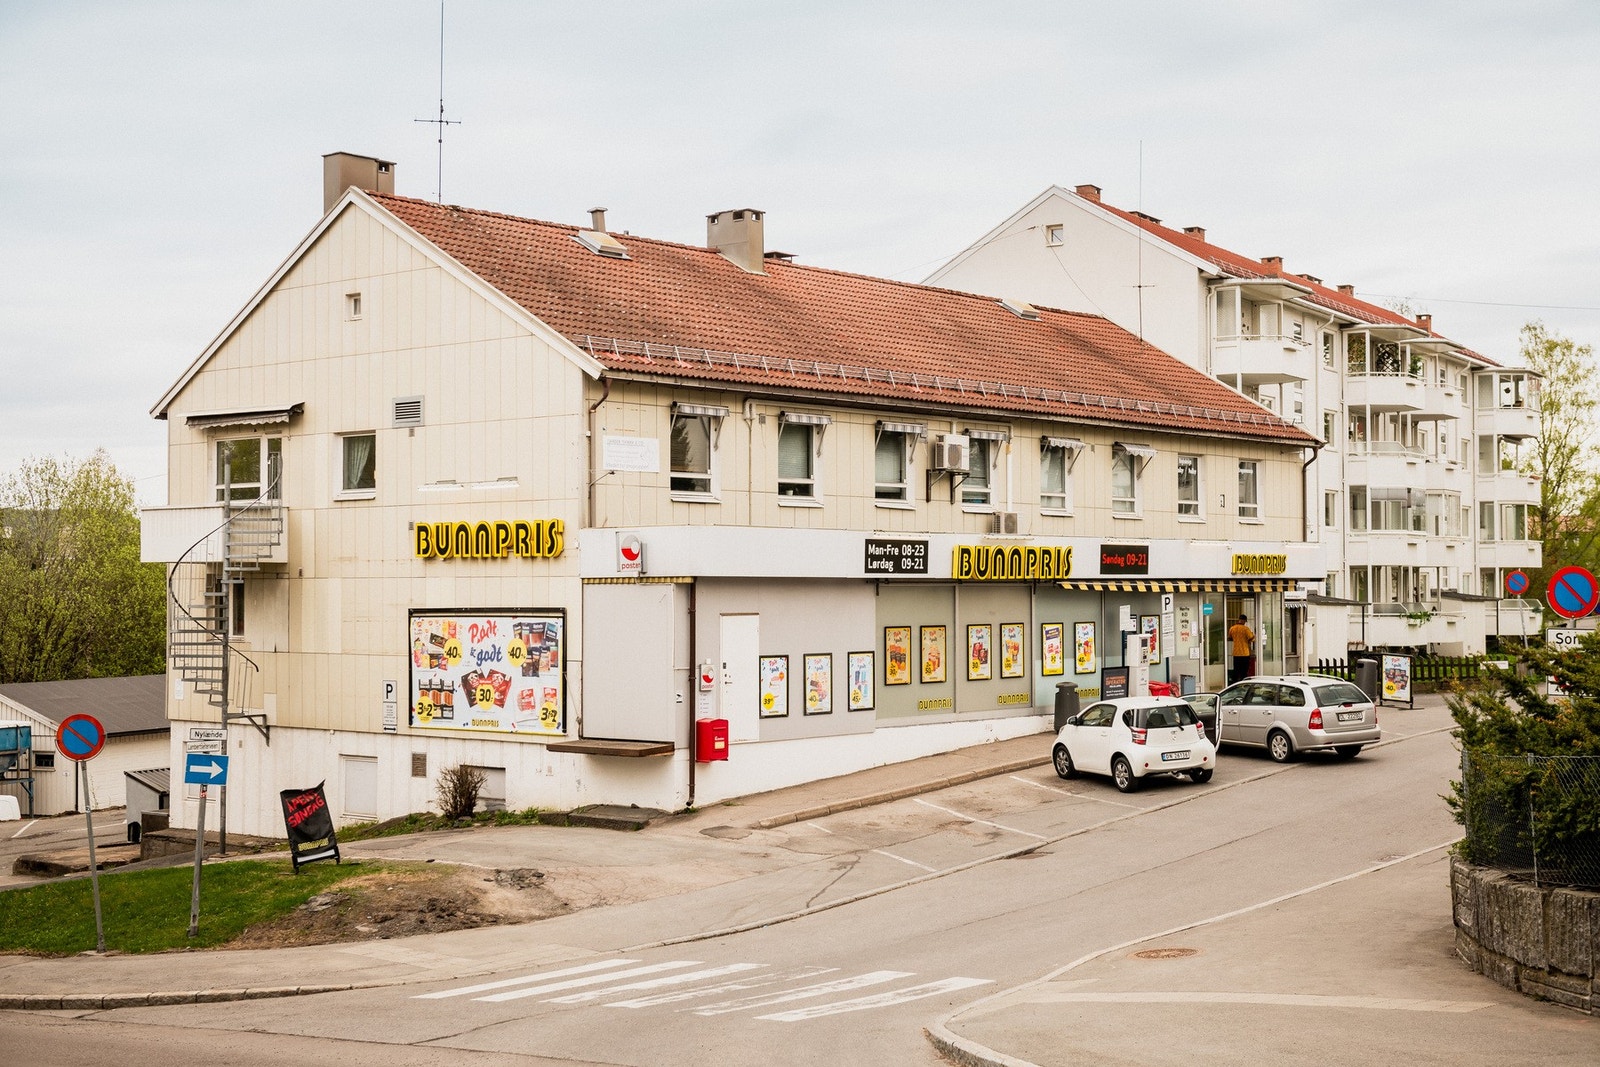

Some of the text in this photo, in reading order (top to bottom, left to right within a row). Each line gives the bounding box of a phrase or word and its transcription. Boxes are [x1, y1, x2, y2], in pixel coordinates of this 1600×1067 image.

[416, 519, 564, 559] BUNNPRIS
[867, 543, 925, 556] Man-Fre 08-23
[867, 557, 924, 572] Lørdag 09-21
[952, 545, 1073, 580] BUNNPRIS
[1102, 553, 1147, 567] Søndag 09-21
[1231, 553, 1288, 575] BUNNPRIS
[1164, 596, 1171, 611] P
[386, 683, 393, 699] P
[194, 730, 223, 739] Nylænde
